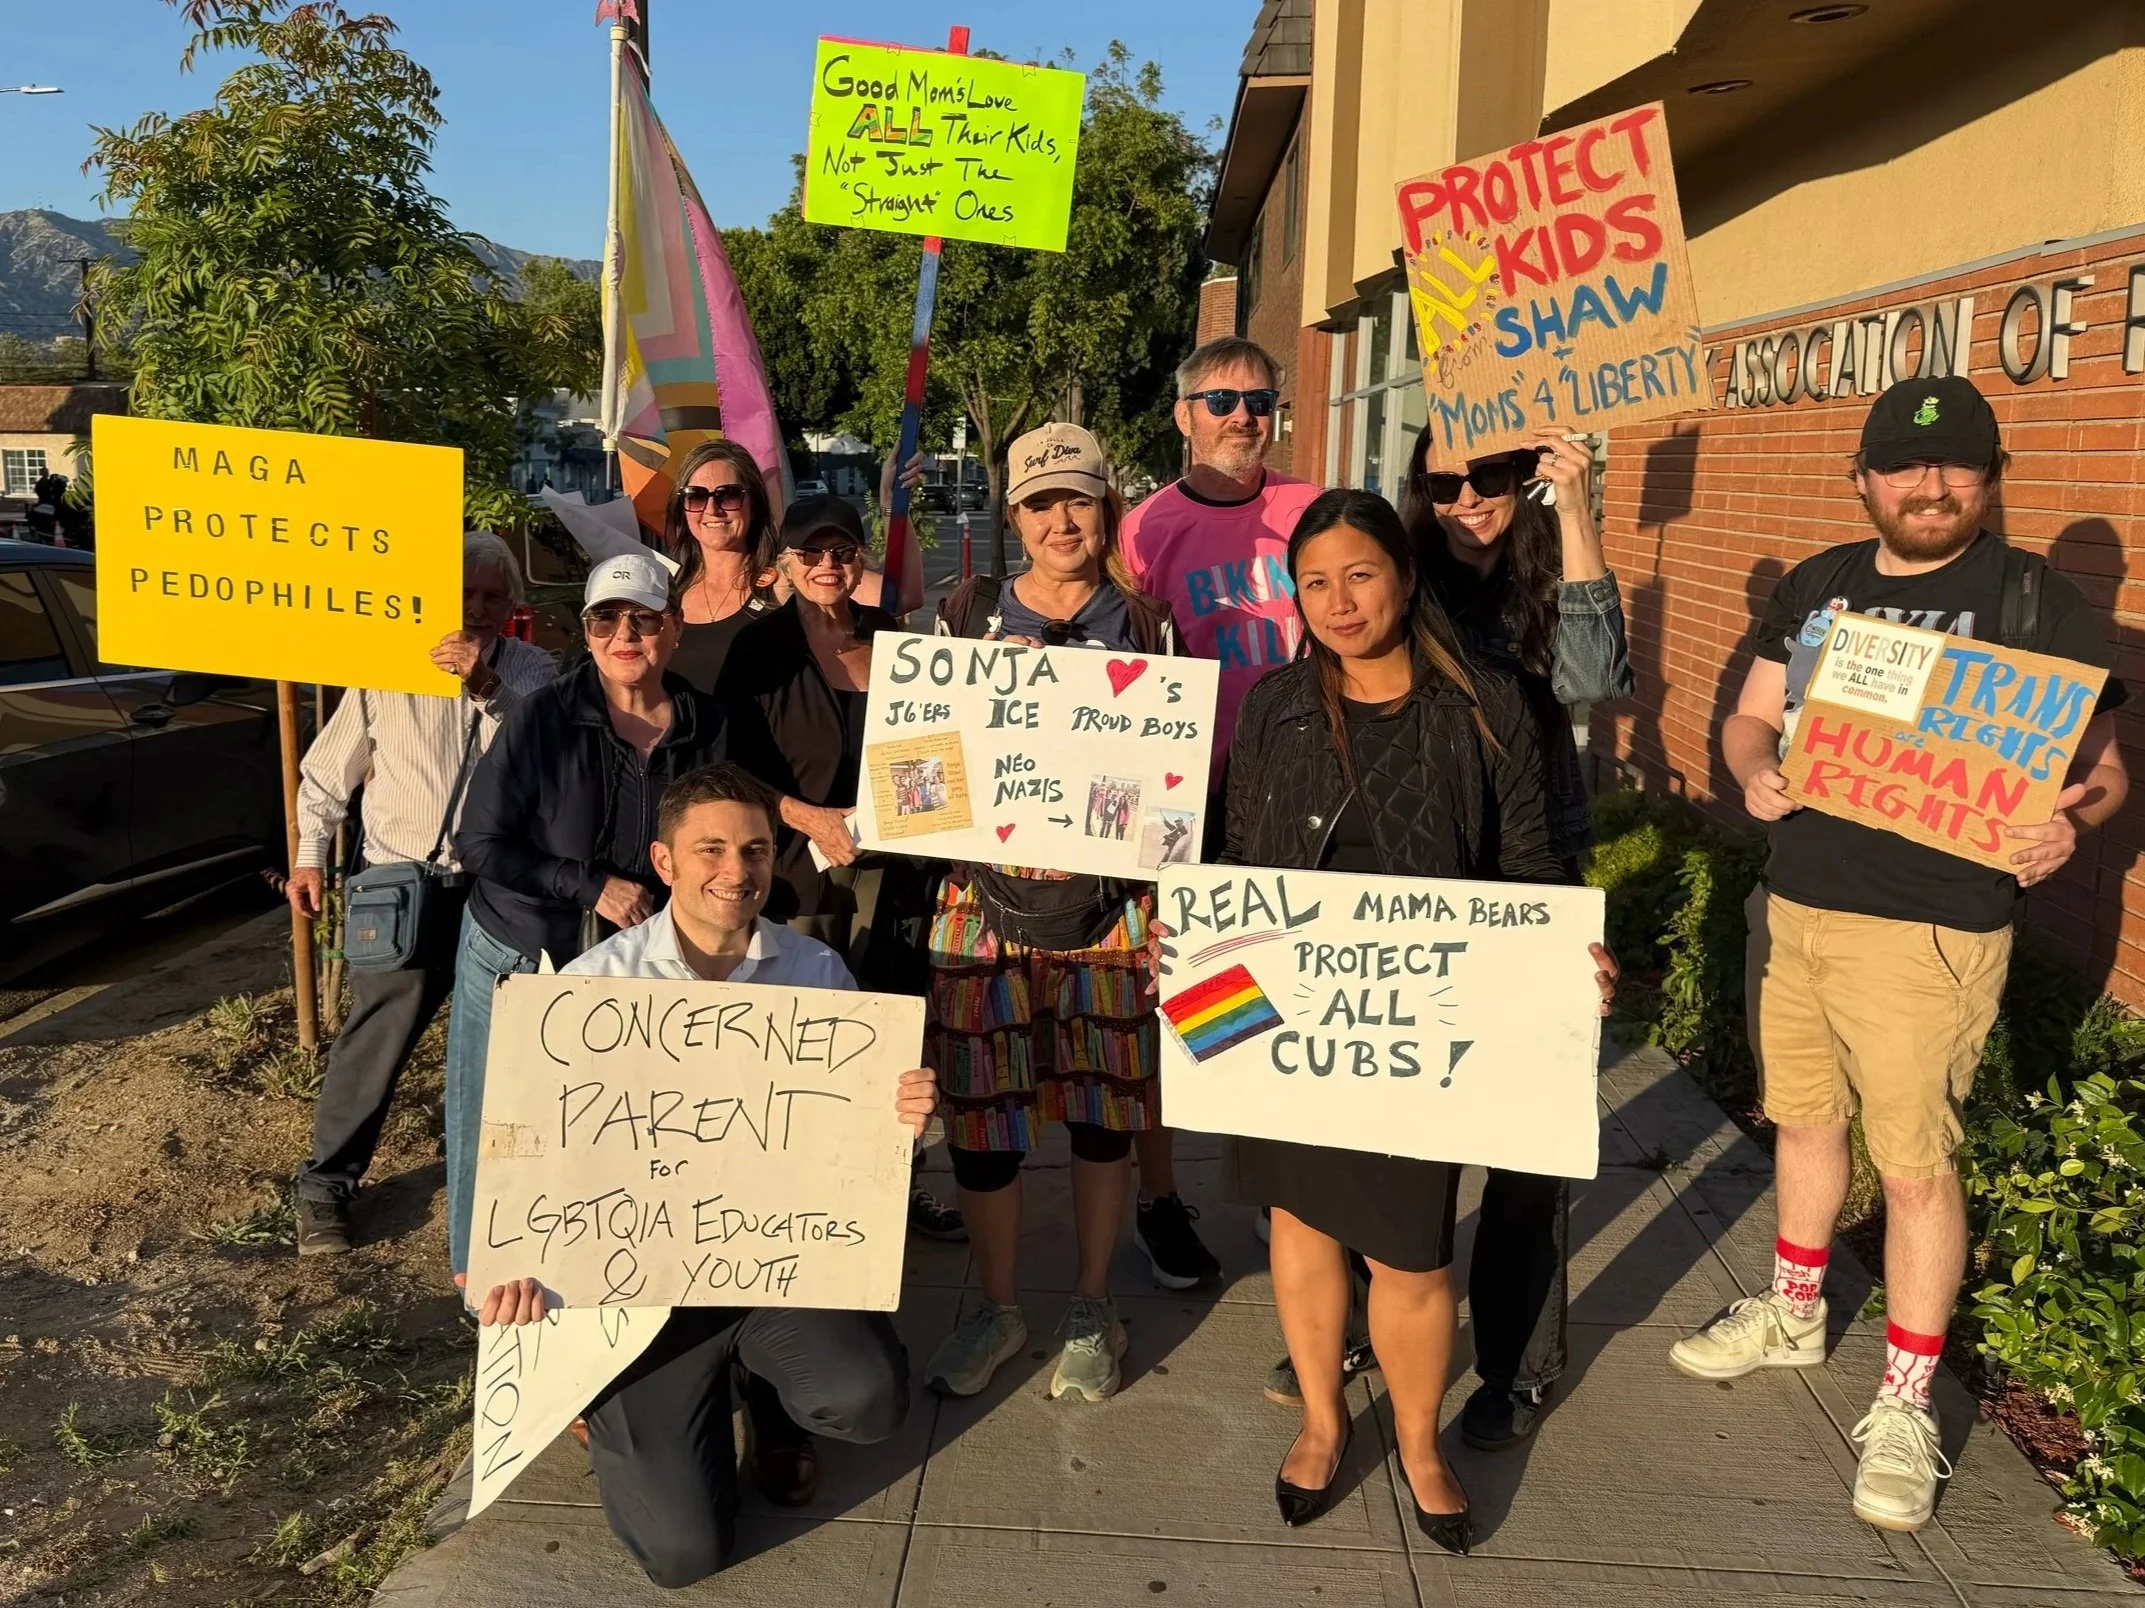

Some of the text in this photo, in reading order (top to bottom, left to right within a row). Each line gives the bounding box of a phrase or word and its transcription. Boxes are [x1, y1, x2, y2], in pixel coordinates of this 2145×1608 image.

[823, 55, 1018, 111] Good Mom's Love
[847, 103, 1061, 163] ALL Their Kids,
[823, 143, 1014, 182] Not Just The
[1397, 107, 1661, 257] PROTECT
[955, 190, 1014, 222] Ones
[1411, 194, 1664, 356] ALL KIDS
[1493, 262, 1668, 358] SHAW
[1725, 297, 1974, 408] ASSOCIATION
[2001, 275, 2096, 385] OF
[1533, 377, 1556, 421] 4
[173, 446, 306, 485] MAGA
[1024, 444, 1082, 473] Surf Diva
[144, 504, 390, 555] PROTECTS
[130, 567, 423, 625] PEDOPHILES!
[889, 637, 1060, 696] SONJA
[1832, 627, 1933, 671] DIVERSITY
[1834, 655, 1915, 686] is the one thing
[1831, 670, 1909, 696] we ALL have in
[1841, 683, 1889, 704] common.
[1941, 646, 2098, 741] TRANS
[985, 698, 1040, 729] ICE
[1071, 705, 1133, 733] PROUD
[1139, 716, 1199, 741] BOYS
[1892, 729, 1926, 750] are
[1917, 705, 2069, 783] RIGHTS
[993, 752, 1036, 779] NEO
[993, 777, 1065, 808] NAZIS
[1803, 715, 2031, 819] HUMAN
[1802, 758, 2010, 854] RIGHTS
[1170, 874, 1552, 936] REAL MAMA BEARS
[1293, 941, 1469, 981] PROTECT
[540, 990, 877, 1074] CONCERNED
[1319, 987, 1416, 1030] ALL
[559, 1081, 852, 1152] PARENT
[487, 1187, 866, 1264] LGBTQIA EDUCATORS
[598, 1247, 800, 1307] & YOUTH
